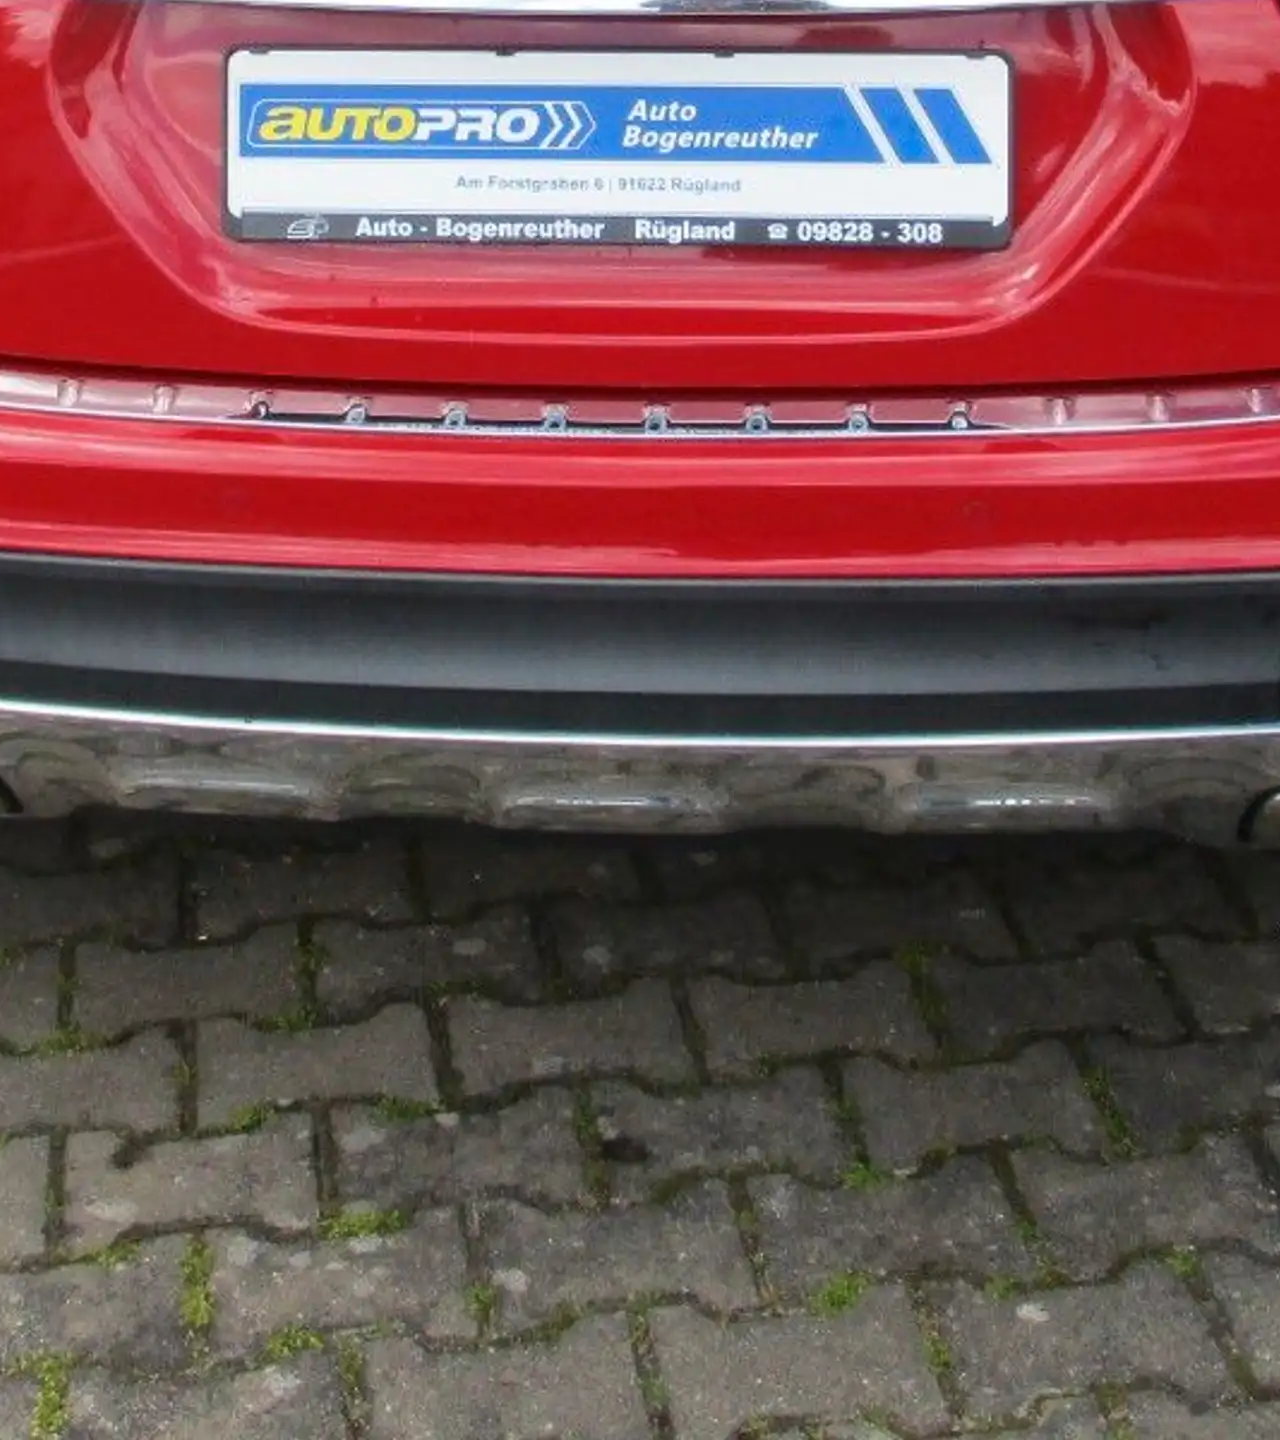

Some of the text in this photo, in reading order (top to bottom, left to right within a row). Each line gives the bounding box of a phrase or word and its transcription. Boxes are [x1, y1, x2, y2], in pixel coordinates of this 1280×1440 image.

[626, 98, 698, 121] Auto
[622, 125, 818, 153] Bogenreuther
[455, 175, 483, 190] Am
[671, 176, 742, 195] Rügland
[354, 216, 413, 238] Auto
[435, 217, 605, 243] Bogenreuther
[634, 219, 737, 244] Rügland
[796, 222, 875, 242] 09828
[896, 223, 944, 244] 308
